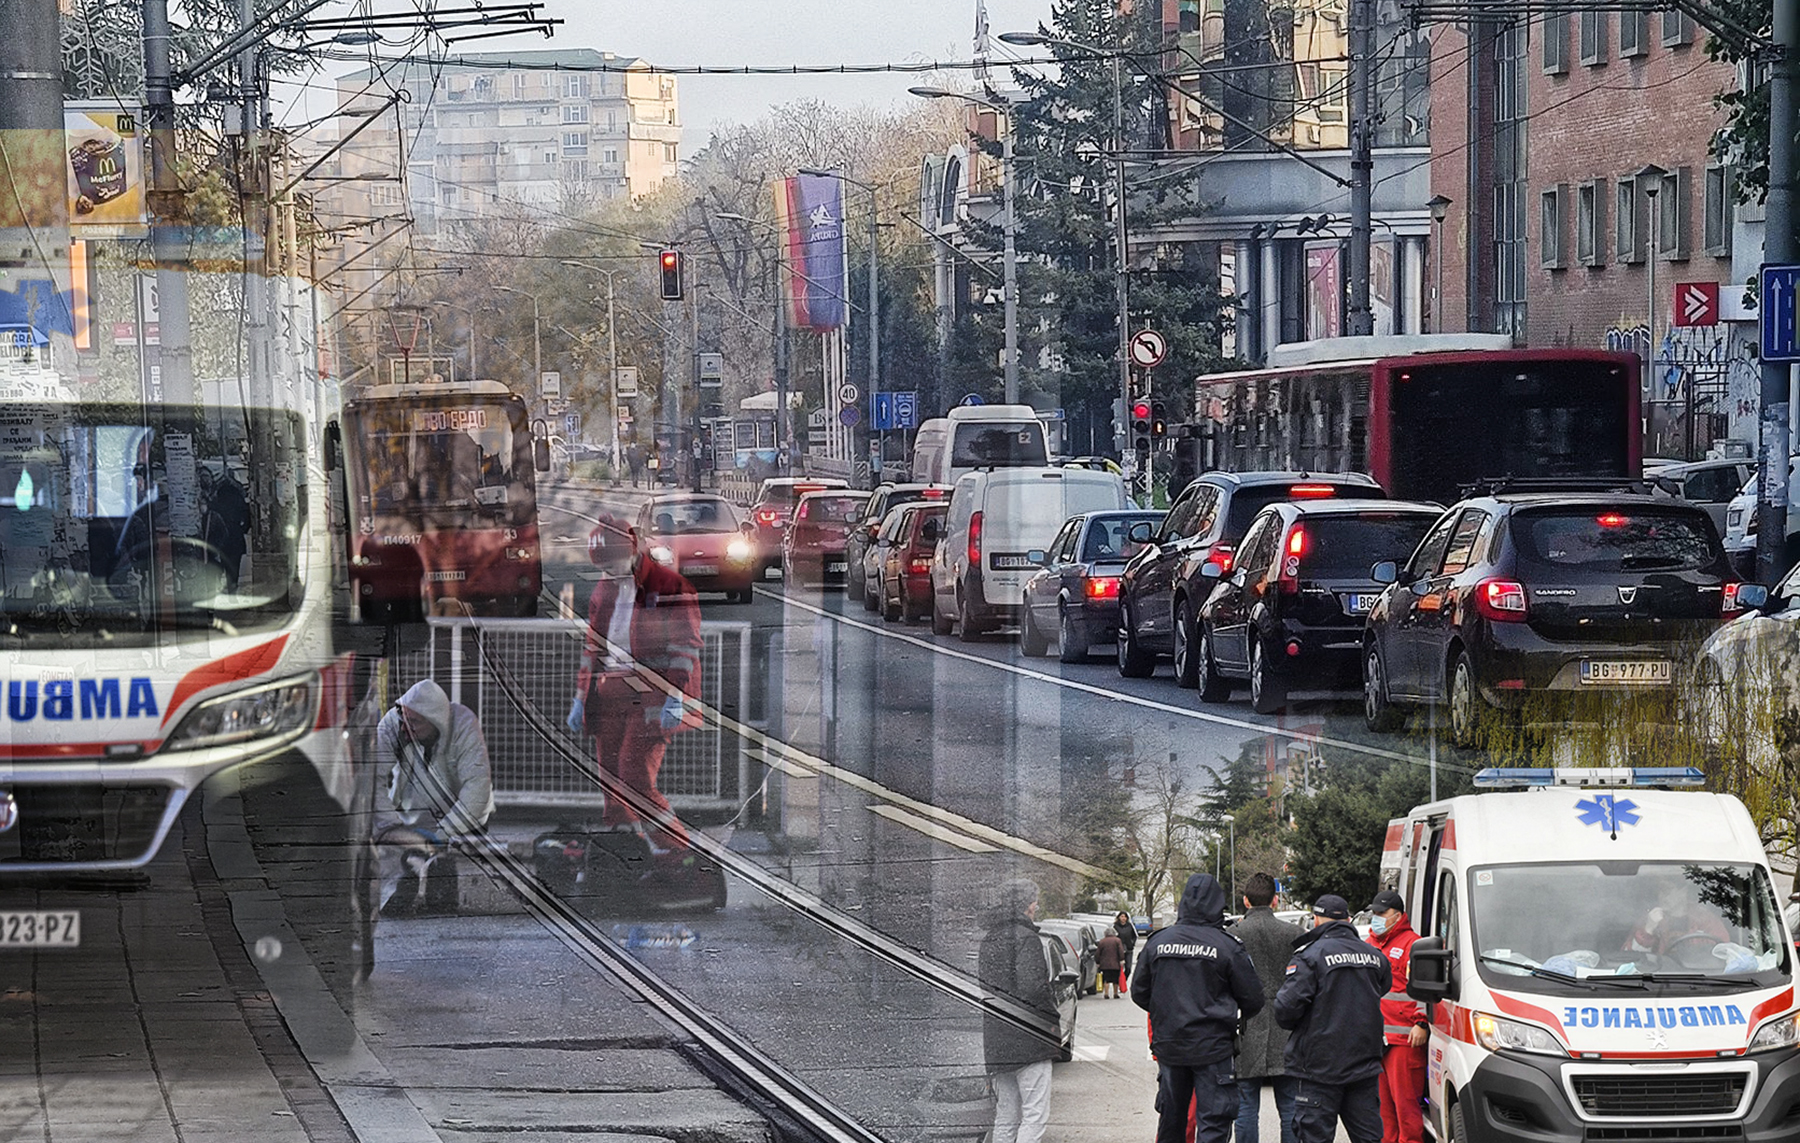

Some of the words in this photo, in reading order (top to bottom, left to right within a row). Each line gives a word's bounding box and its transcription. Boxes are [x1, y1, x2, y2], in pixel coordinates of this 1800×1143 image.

[842, 387, 856, 400] 40
[1018, 432, 1031, 444] E2
[504, 528, 518, 540] 33
[1156, 943, 1219, 959] ПОЛИЦИЈА
